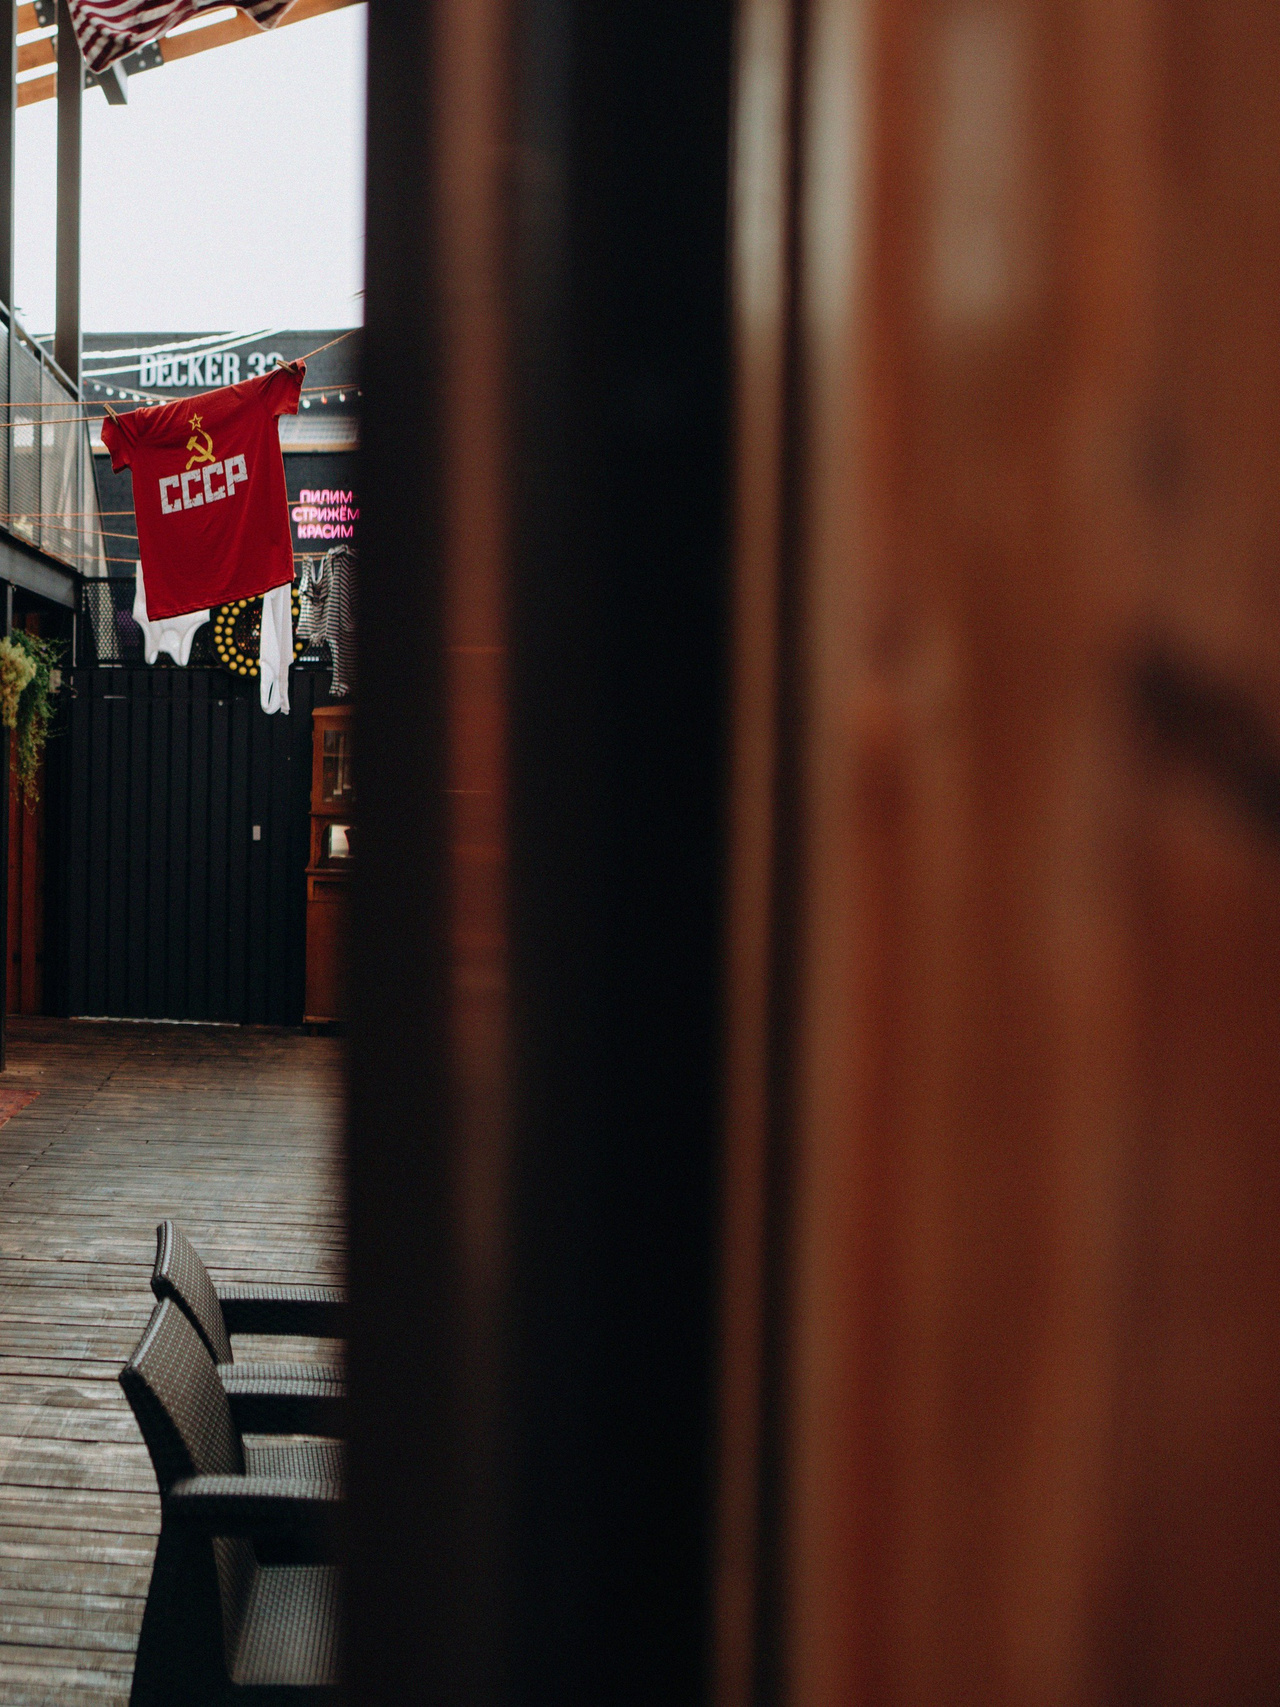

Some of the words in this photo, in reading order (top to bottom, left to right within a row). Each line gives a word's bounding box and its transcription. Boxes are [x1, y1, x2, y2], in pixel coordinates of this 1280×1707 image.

[139, 352, 240, 387] DECKER
[159, 453, 248, 515] СССР
[299, 489, 353, 504] ПИЛИМ
[291, 504, 360, 522] СТРИЖЁМ
[297, 523, 354, 539] КРАСИМ
